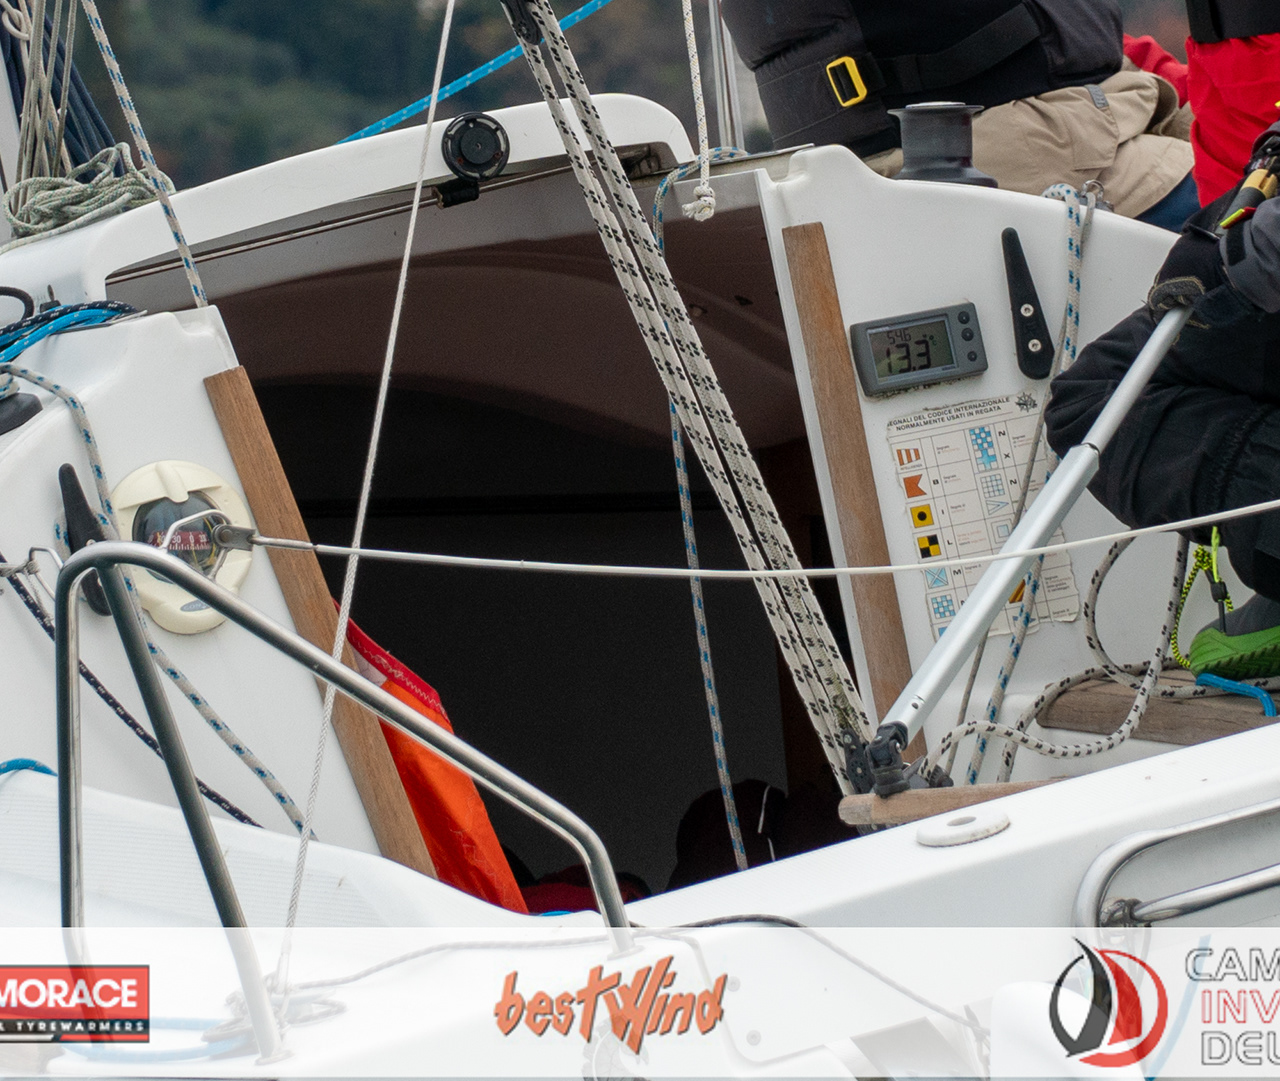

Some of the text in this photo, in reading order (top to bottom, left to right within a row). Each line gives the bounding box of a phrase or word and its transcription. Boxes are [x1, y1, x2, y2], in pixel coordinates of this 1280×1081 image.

[896, 416, 946, 431] NORMALMENTE
[946, 412, 966, 421] USATI
[975, 405, 1001, 415] REGATA
[927, 408, 953, 419] CODICE
[953, 396, 1010, 413] INTERNAZIONALE
